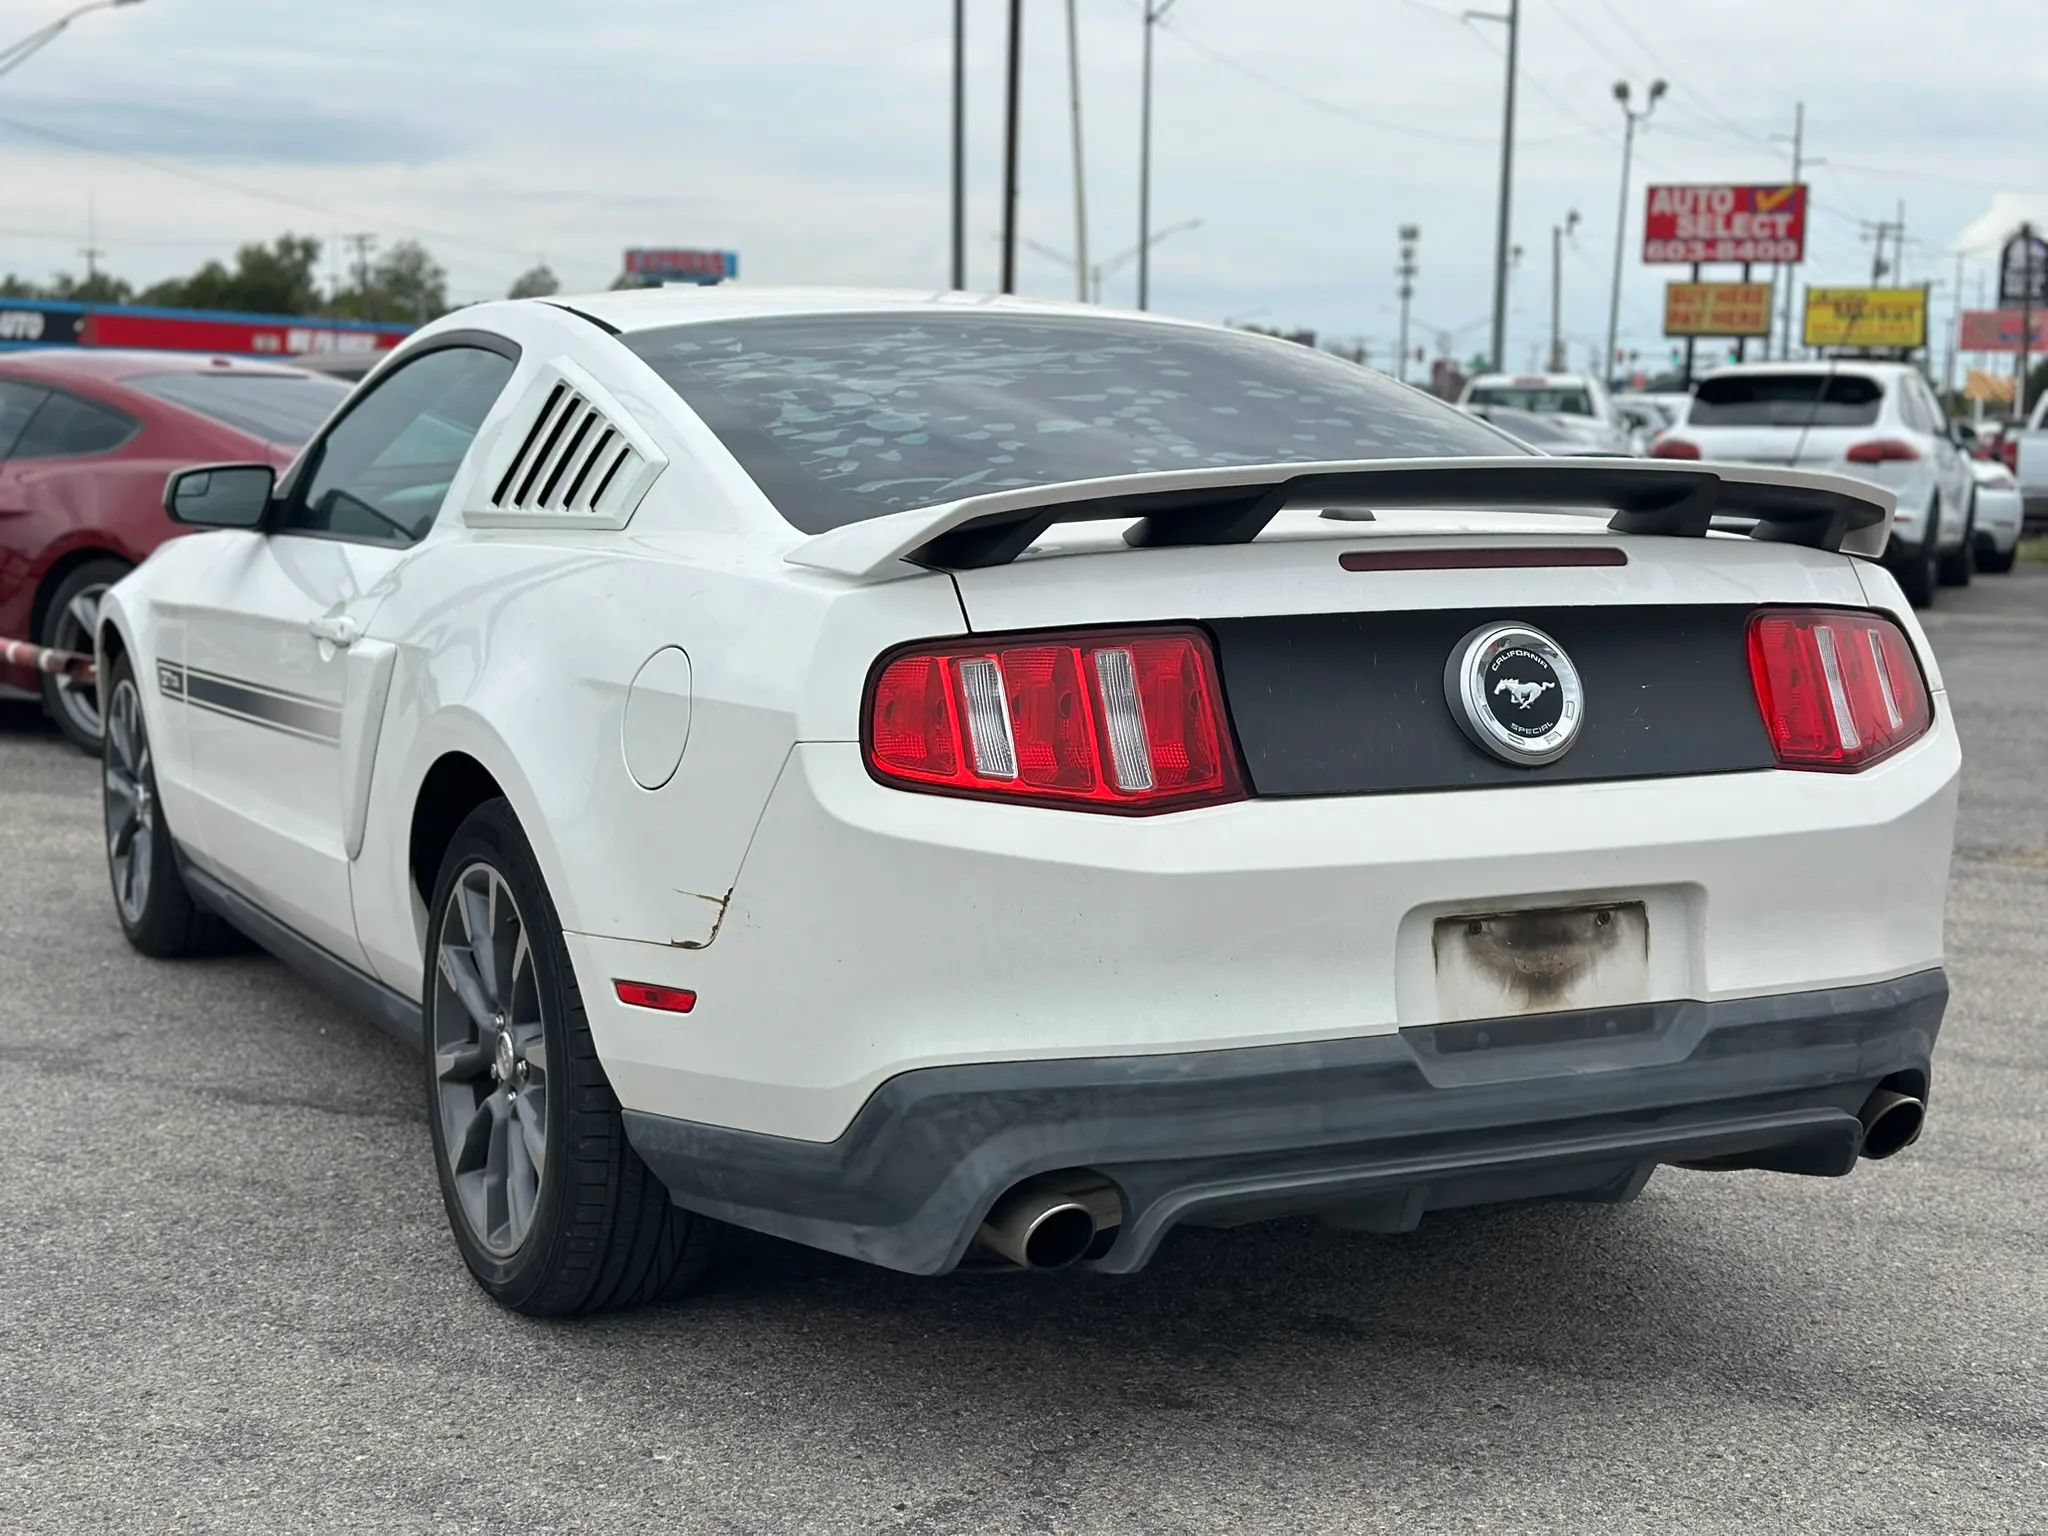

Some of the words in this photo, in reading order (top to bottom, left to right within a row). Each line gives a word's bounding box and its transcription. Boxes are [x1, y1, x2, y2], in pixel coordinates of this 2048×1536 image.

[1650, 186, 1736, 216] AUTO
[1676, 212, 1795, 239] SELECT
[1491, 649, 1548, 672] CALIFORNIA
[1510, 722, 1554, 735] SPECIAL
